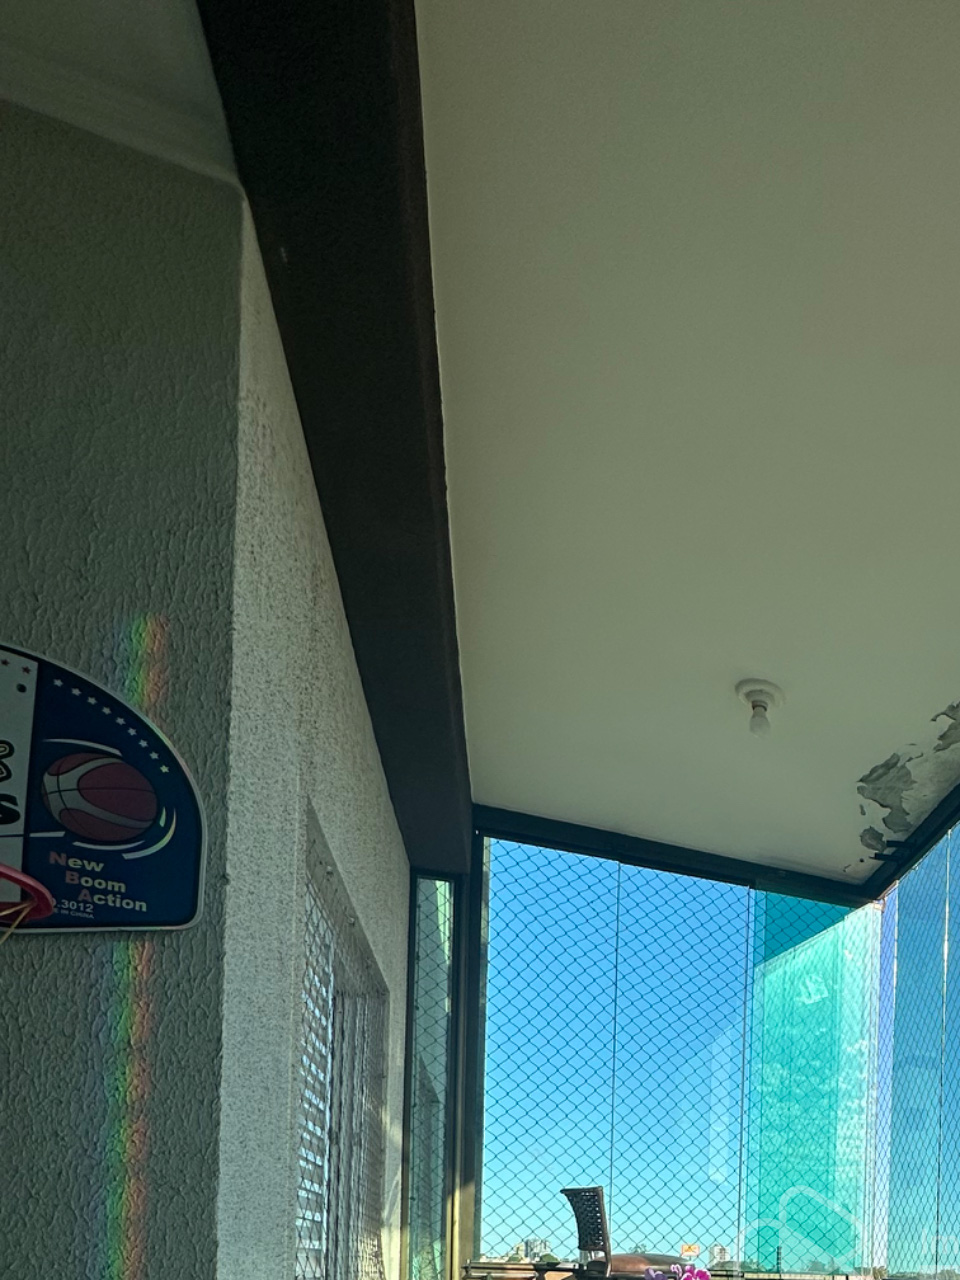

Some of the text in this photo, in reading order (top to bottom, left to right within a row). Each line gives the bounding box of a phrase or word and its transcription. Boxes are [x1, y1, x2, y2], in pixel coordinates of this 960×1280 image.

[49, 851, 104, 872] New
[65, 870, 126, 893] Boom
[77, 888, 147, 912] Action
[70, 910, 95, 919] CHINA
